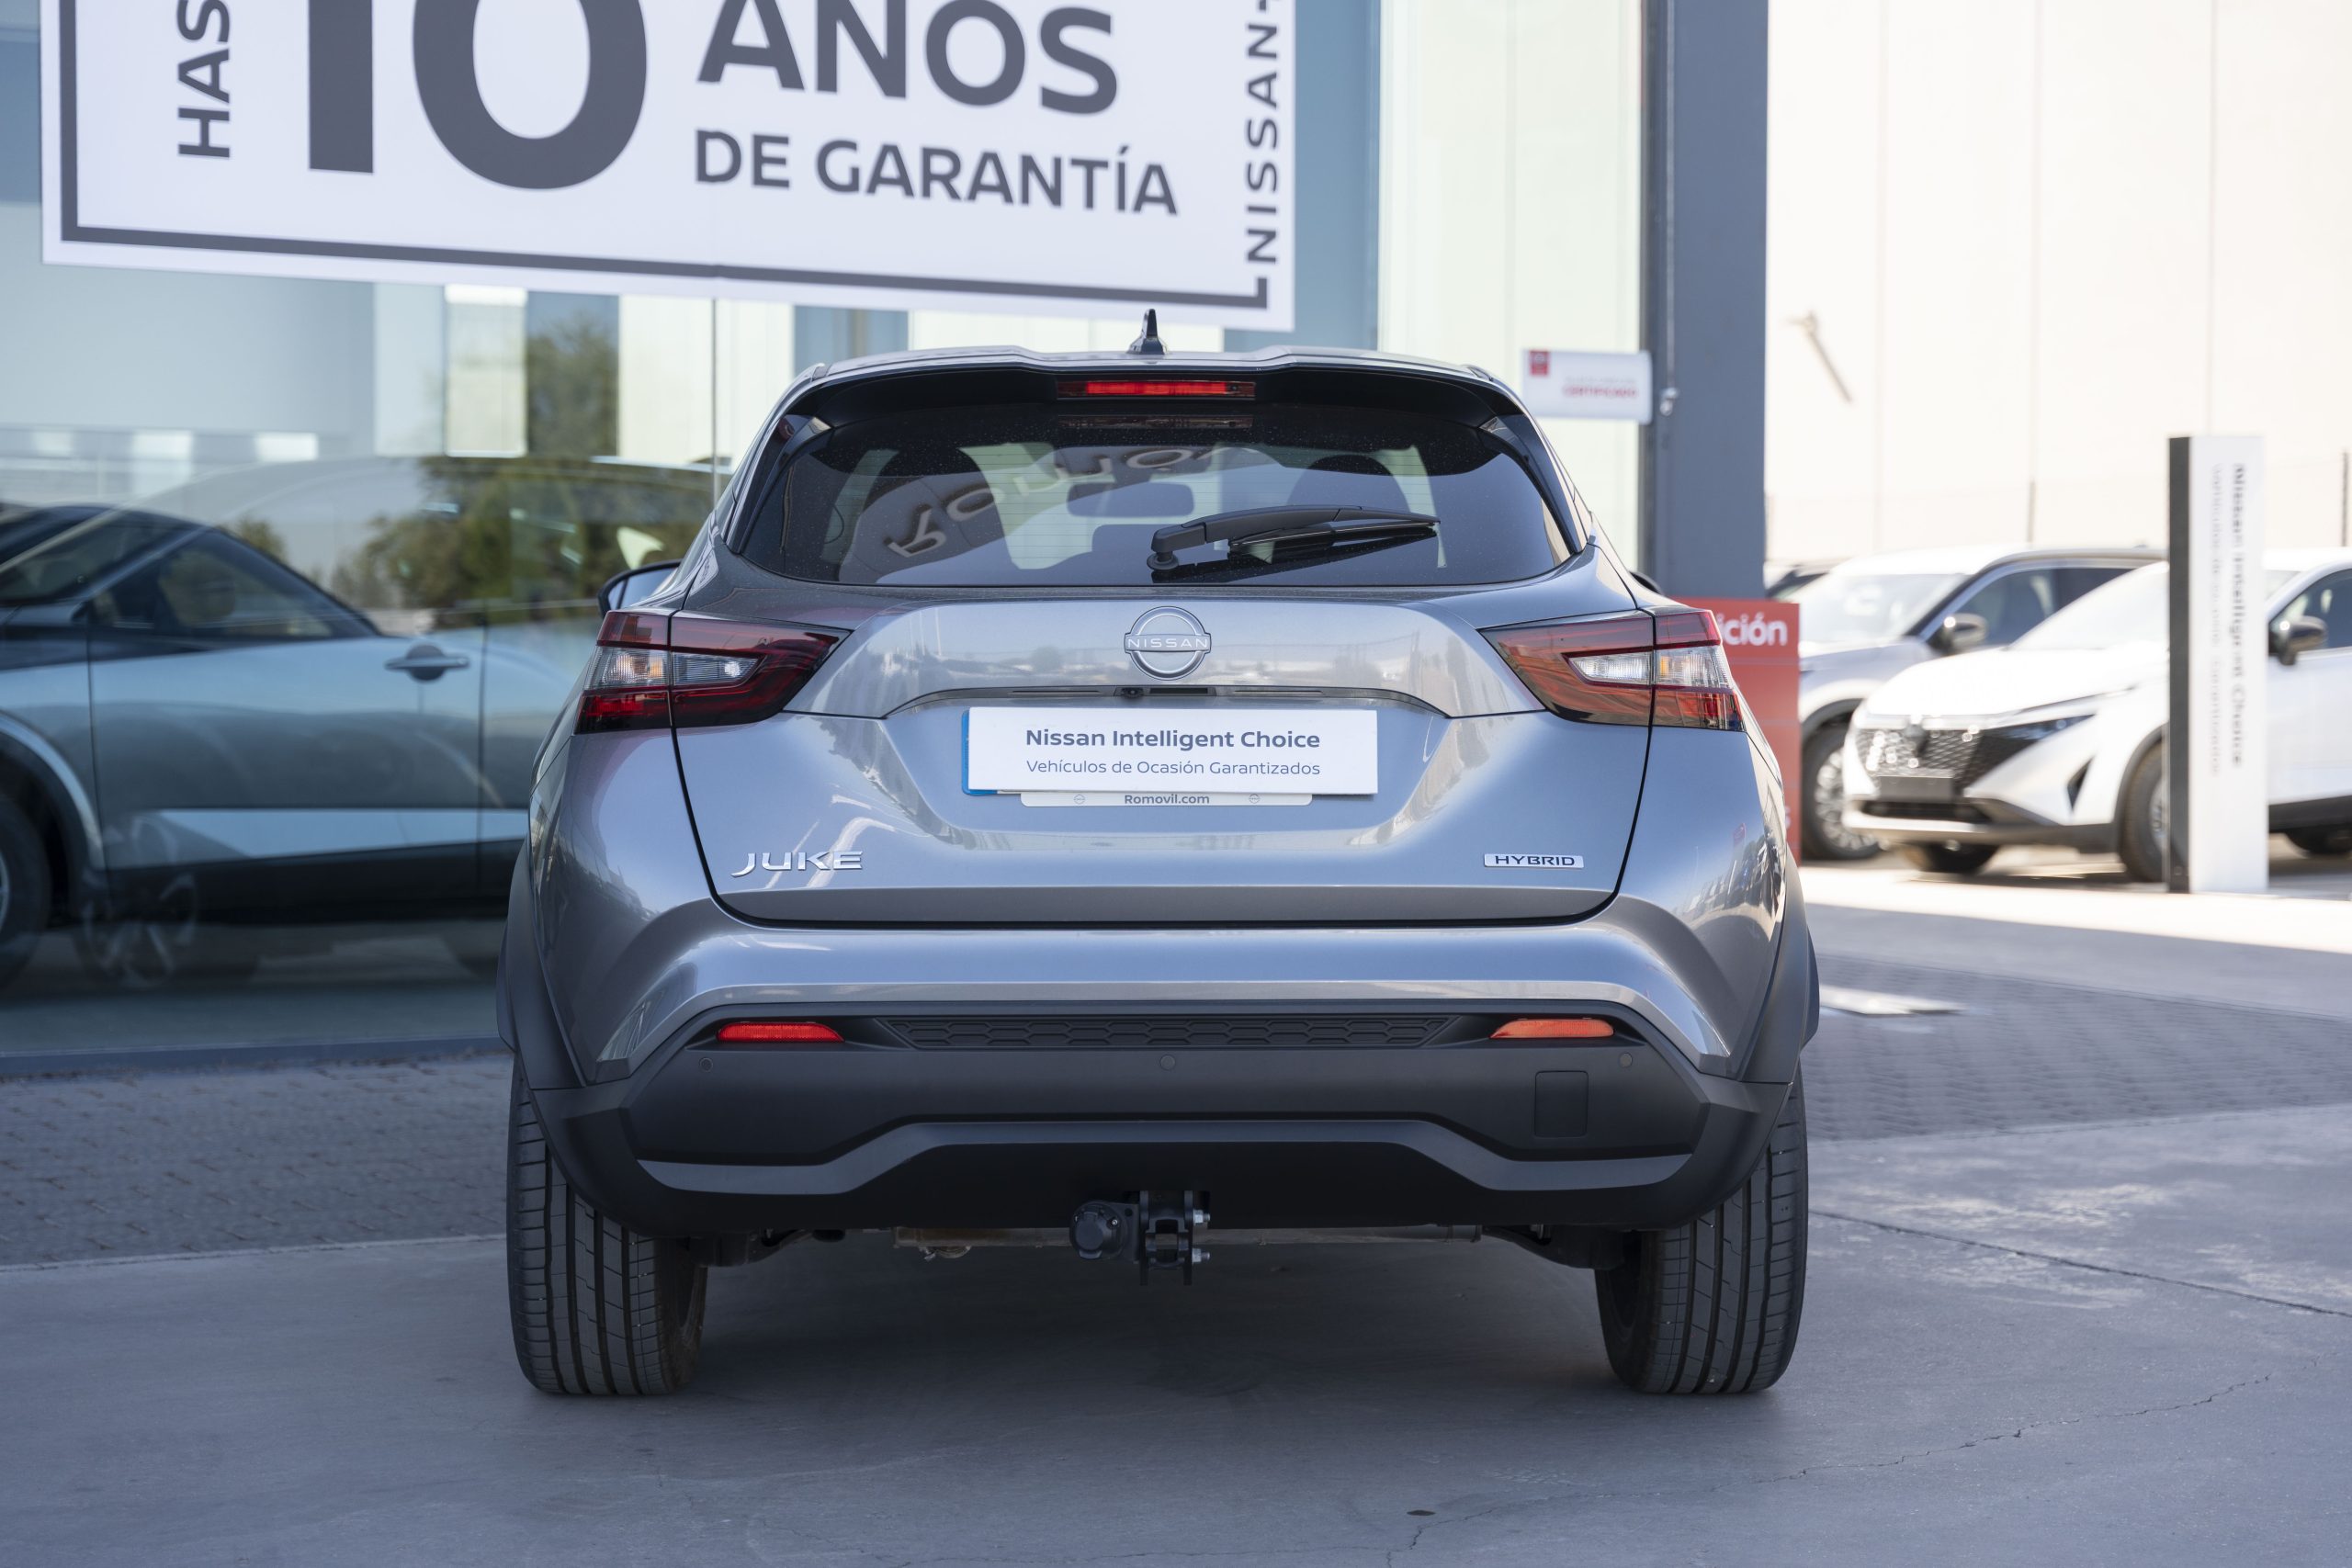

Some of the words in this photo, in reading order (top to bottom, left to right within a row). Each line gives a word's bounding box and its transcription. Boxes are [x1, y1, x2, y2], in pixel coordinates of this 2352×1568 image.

[1247, 23, 1277, 265] NISSAN
[695, 130, 790, 189] DE
[816, 140, 1179, 217] GARANTÍA
[1127, 637, 1207, 649] NISSAN
[1026, 728, 1105, 746] Nissan
[1113, 729, 1235, 751] Intelligent
[1240, 730, 1320, 748] Choice
[1026, 759, 1107, 773] Vehículos
[1112, 761, 1132, 773] de
[1136, 761, 1204, 774] Ocasión
[1209, 761, 1320, 775] Garantizados
[1124, 793, 1210, 805] Romovil.com
[730, 851, 863, 878] JUKE
[1495, 855, 1576, 866] HYBRID
